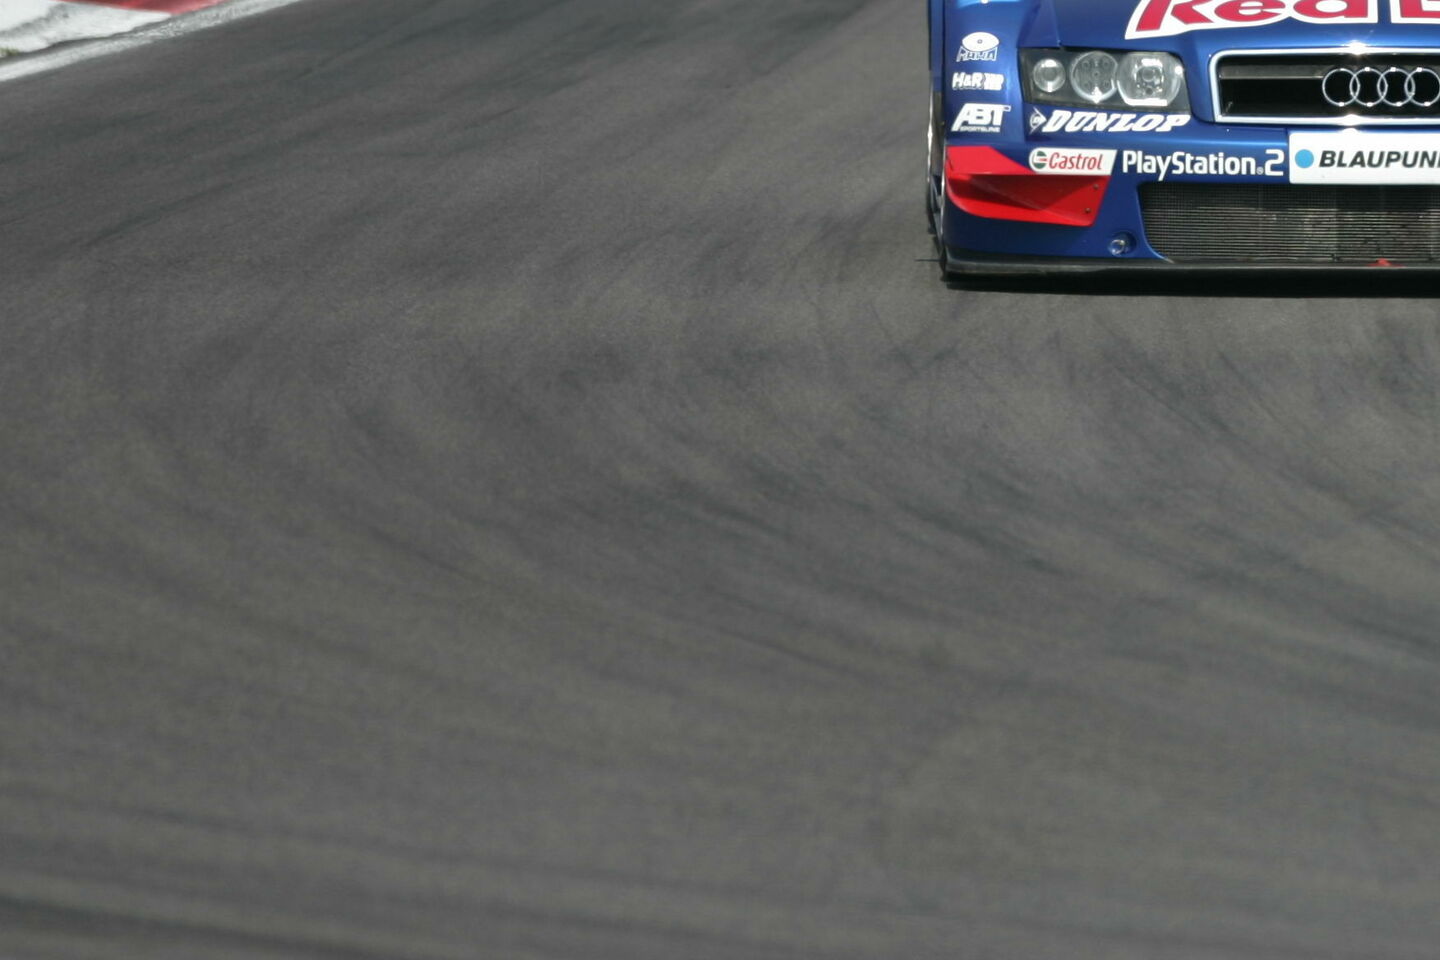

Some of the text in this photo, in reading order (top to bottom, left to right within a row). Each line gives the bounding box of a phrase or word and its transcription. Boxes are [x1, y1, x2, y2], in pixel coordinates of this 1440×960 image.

[951, 103, 1003, 132] ABT
[1042, 109, 1191, 132] DUNLOP
[1049, 152, 1105, 170] Castrol
